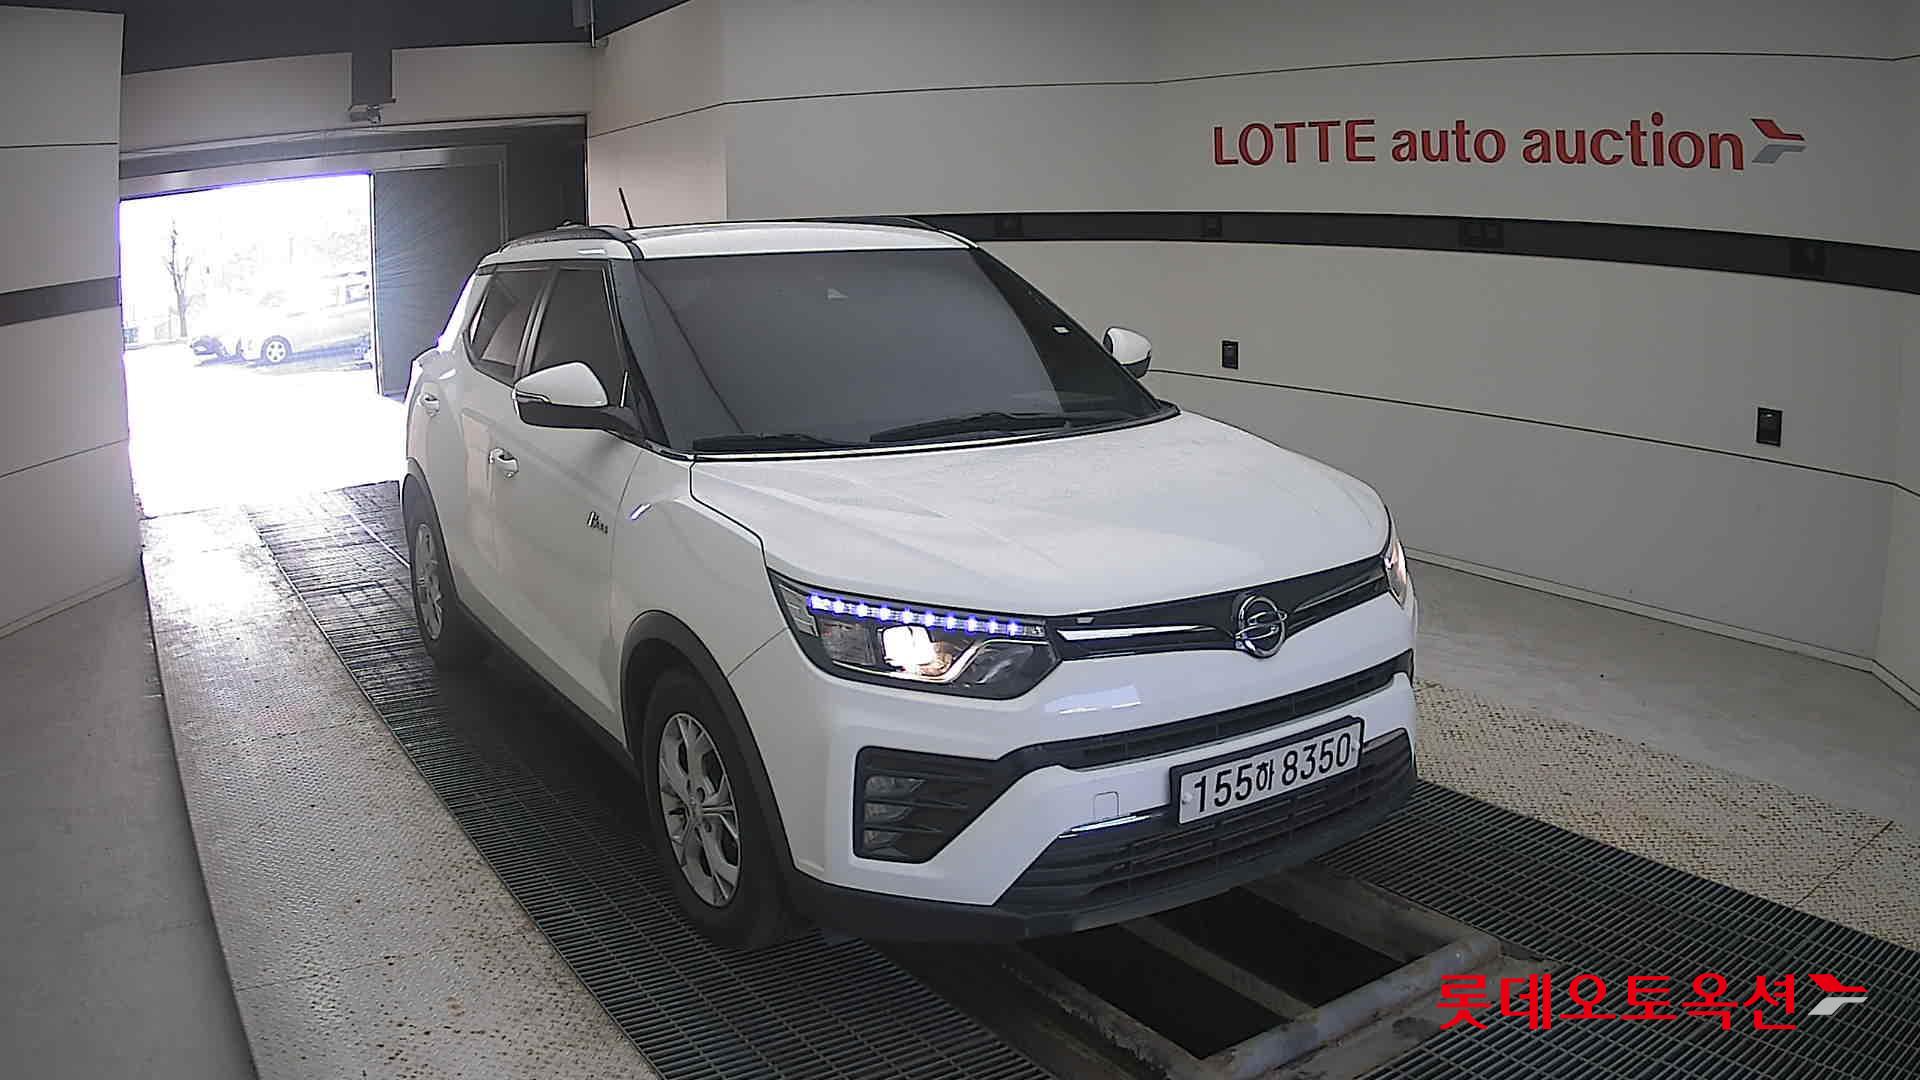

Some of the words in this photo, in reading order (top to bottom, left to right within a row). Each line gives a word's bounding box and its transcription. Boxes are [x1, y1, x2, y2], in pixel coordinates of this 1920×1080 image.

[1213, 119, 1376, 166] LOTTE
[1391, 119, 1506, 164] auto
[1521, 111, 1744, 171] auction
[1194, 759, 1275, 813] 155하
[1281, 732, 1351, 786] 8350
